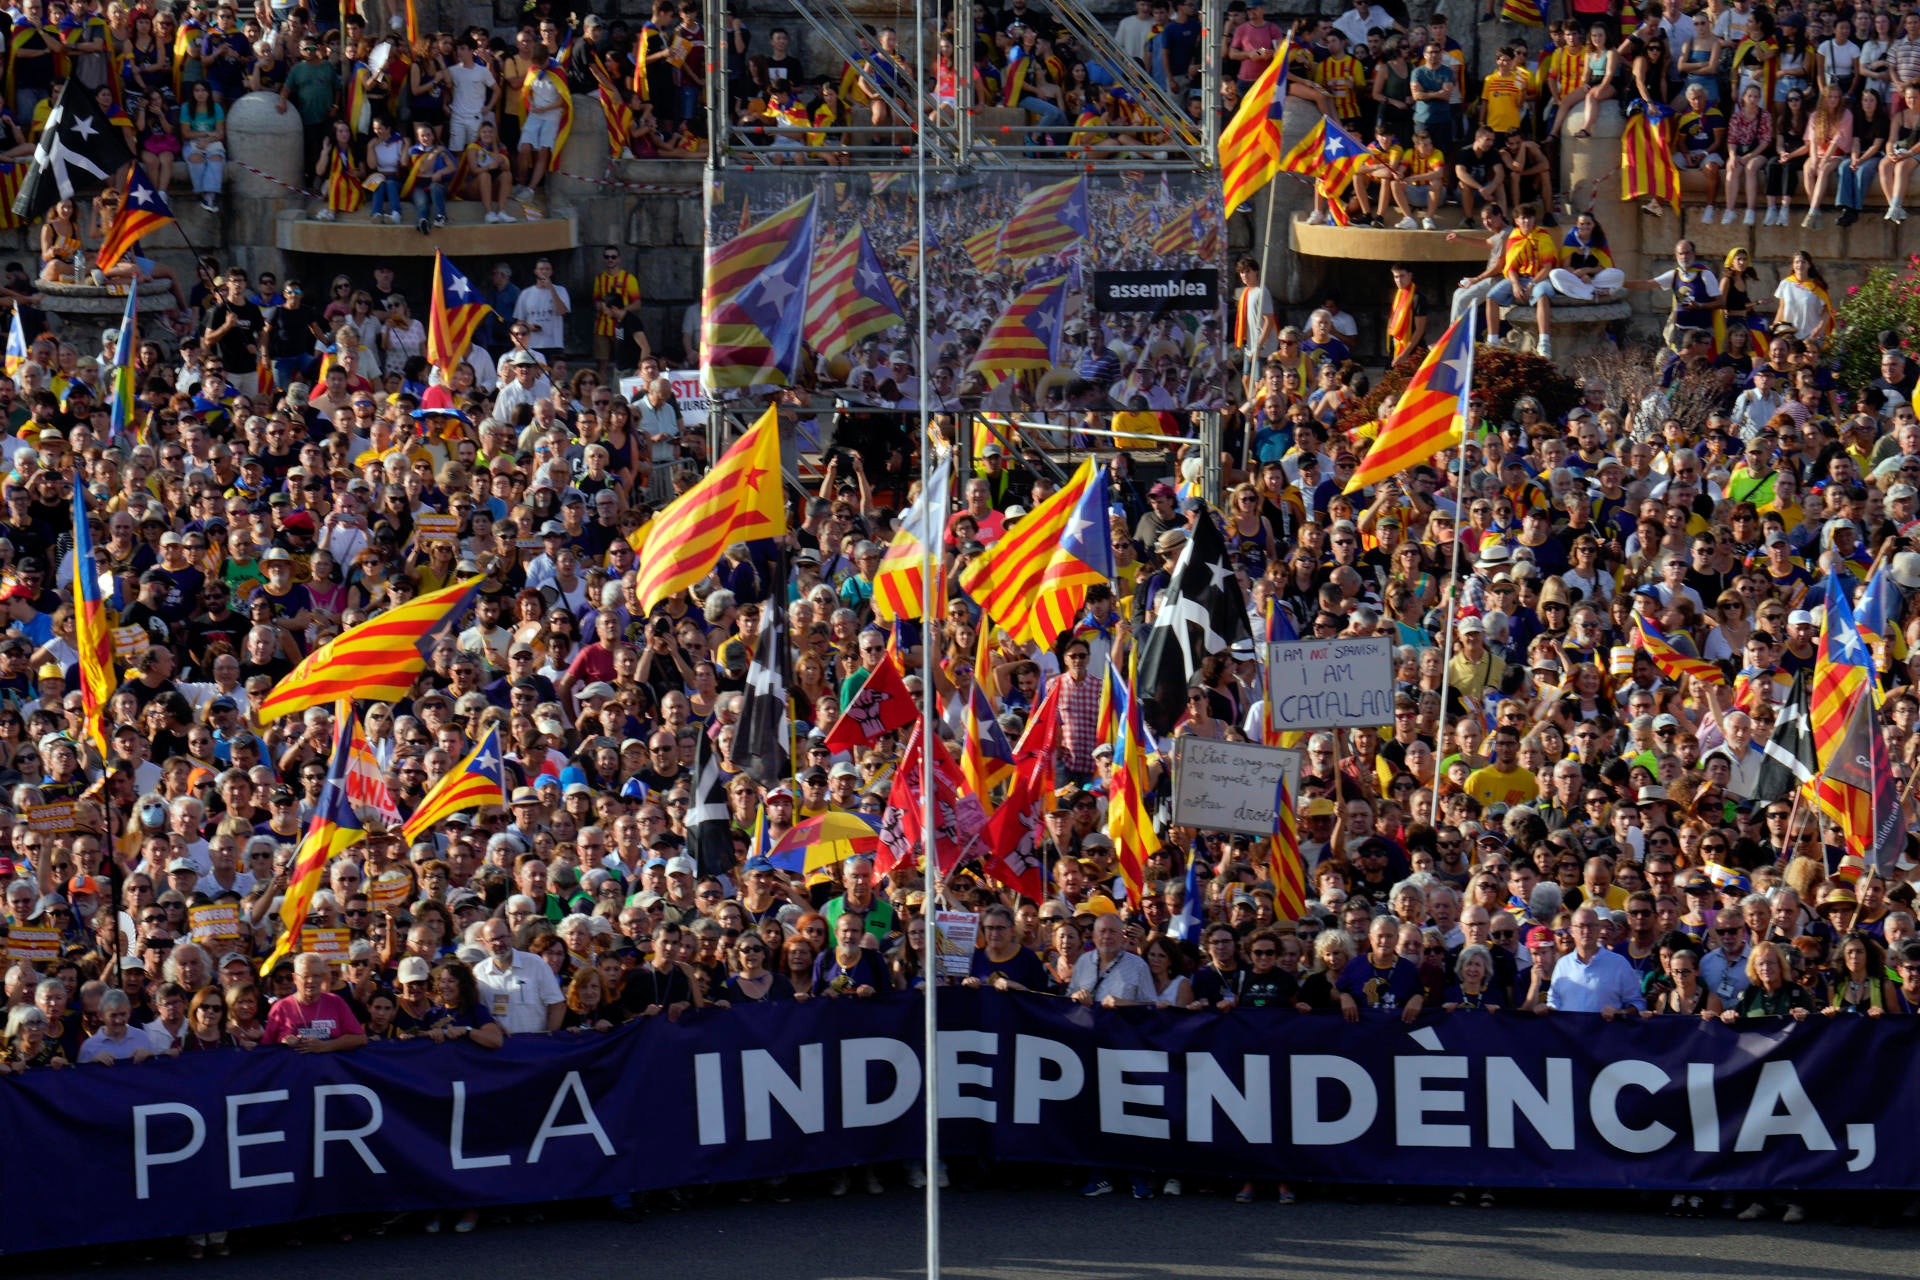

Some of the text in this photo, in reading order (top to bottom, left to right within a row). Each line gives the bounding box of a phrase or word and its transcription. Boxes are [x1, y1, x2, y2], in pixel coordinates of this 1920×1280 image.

[1109, 279, 1207, 298] assemblea
[1284, 648, 1303, 661] AM
[1310, 648, 1329, 660] NOT
[1323, 663, 1354, 683] AM
[1280, 689, 1393, 723] CATALAN
[1261, 775, 1281, 788] pa
[132, 1025, 1877, 1200] PER LA INDEPENDÈNCIA,
